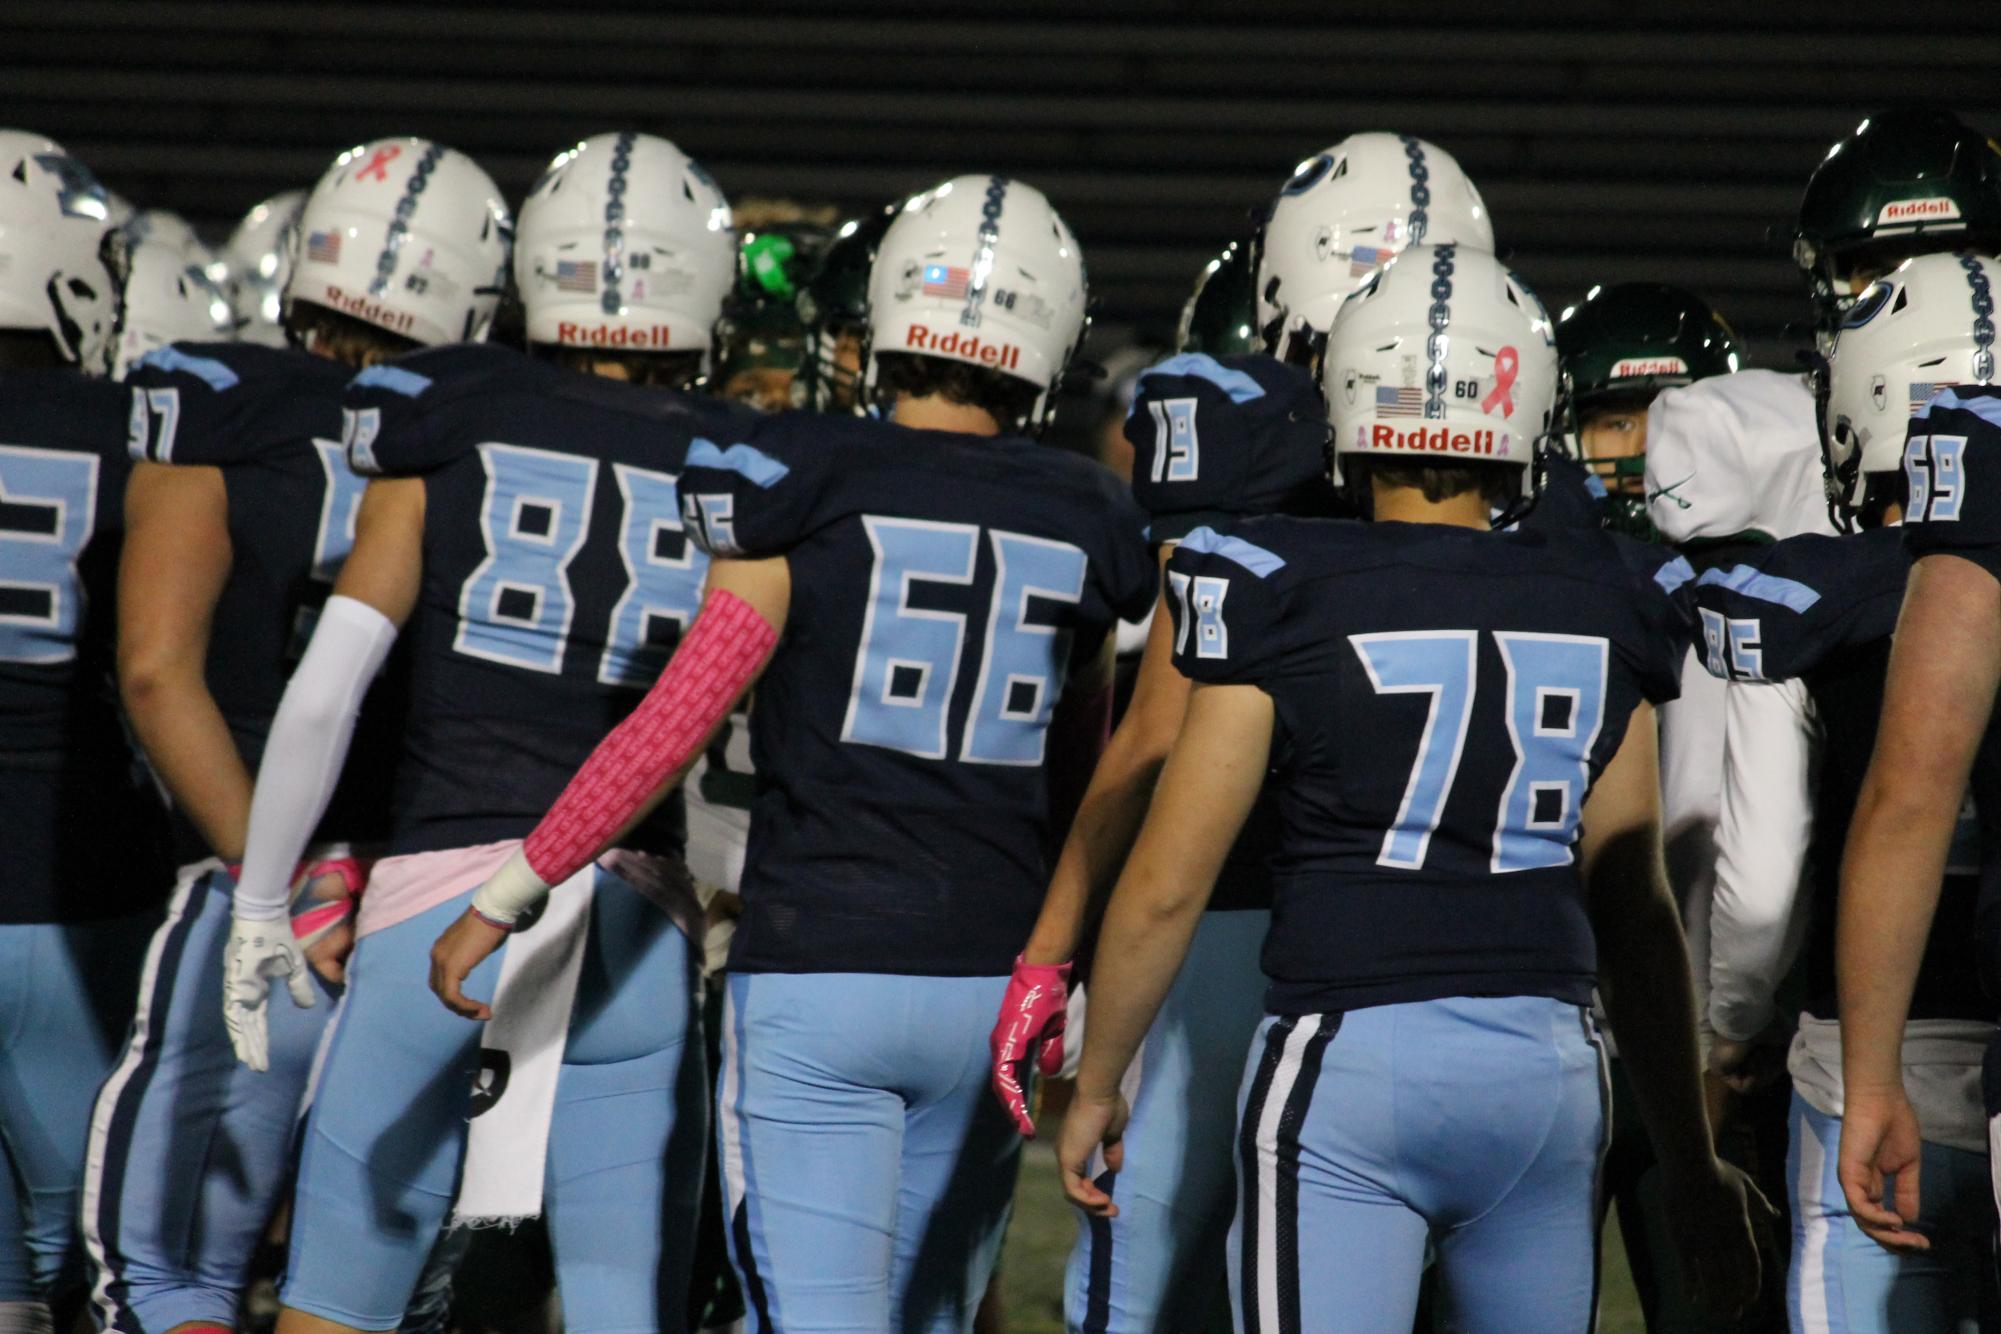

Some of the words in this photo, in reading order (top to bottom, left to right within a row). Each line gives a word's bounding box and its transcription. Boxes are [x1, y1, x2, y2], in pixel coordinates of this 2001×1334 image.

[1887, 201, 1949, 217] Riddell
[326, 286, 414, 331] Riddell
[558, 321, 670, 347] Riddell
[906, 323, 1020, 369] Riddell
[1455, 380, 1479, 399] 60
[1372, 424, 1493, 455] Riddell
[1904, 434, 1968, 522] 69
[453, 442, 706, 687] 88
[840, 514, 1088, 767] 66
[1697, 606, 1765, 681] 85
[1347, 629, 1610, 874] 78
